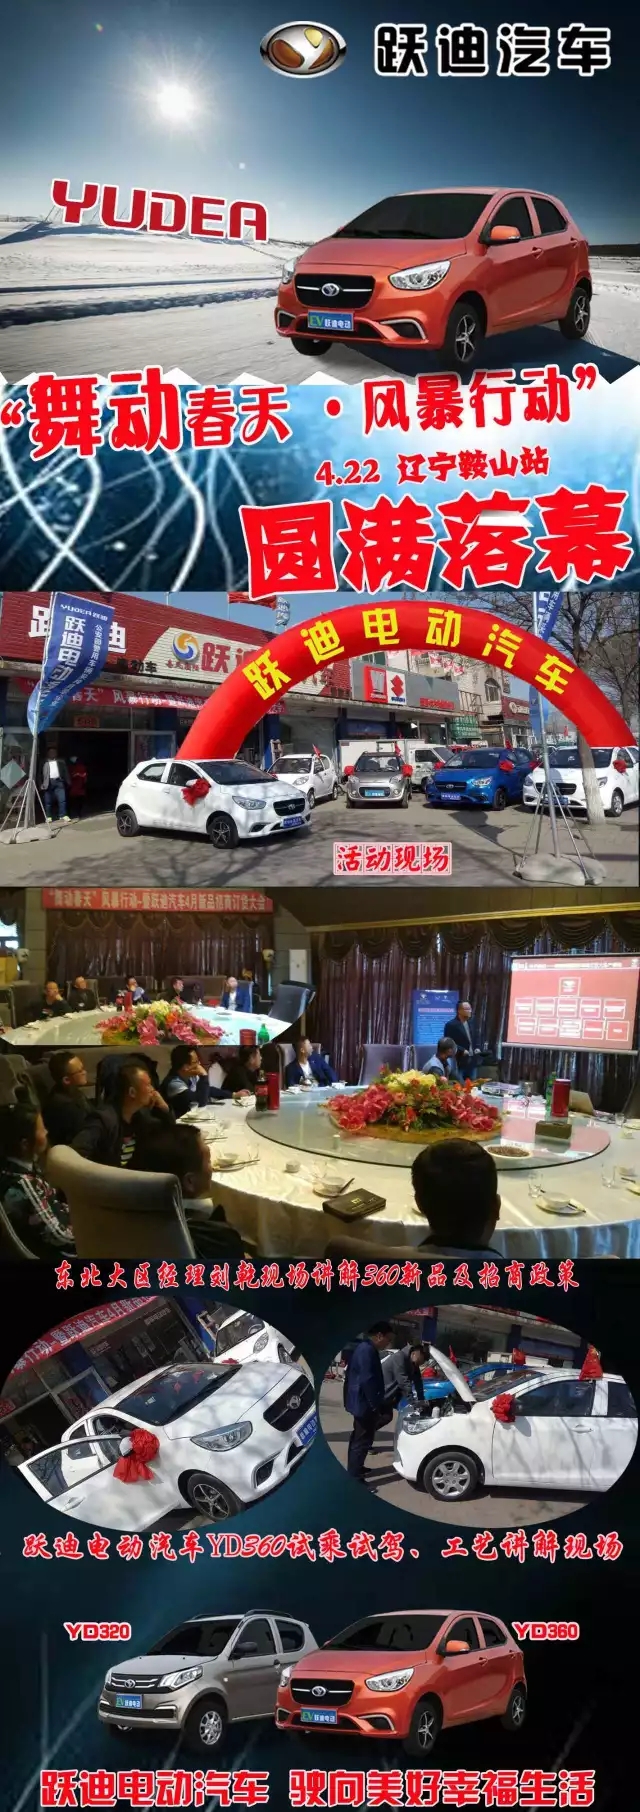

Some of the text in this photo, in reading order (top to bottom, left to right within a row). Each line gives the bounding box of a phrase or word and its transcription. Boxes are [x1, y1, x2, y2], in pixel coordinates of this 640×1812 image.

[242, 607, 575, 701] 跃迪电动汽车
